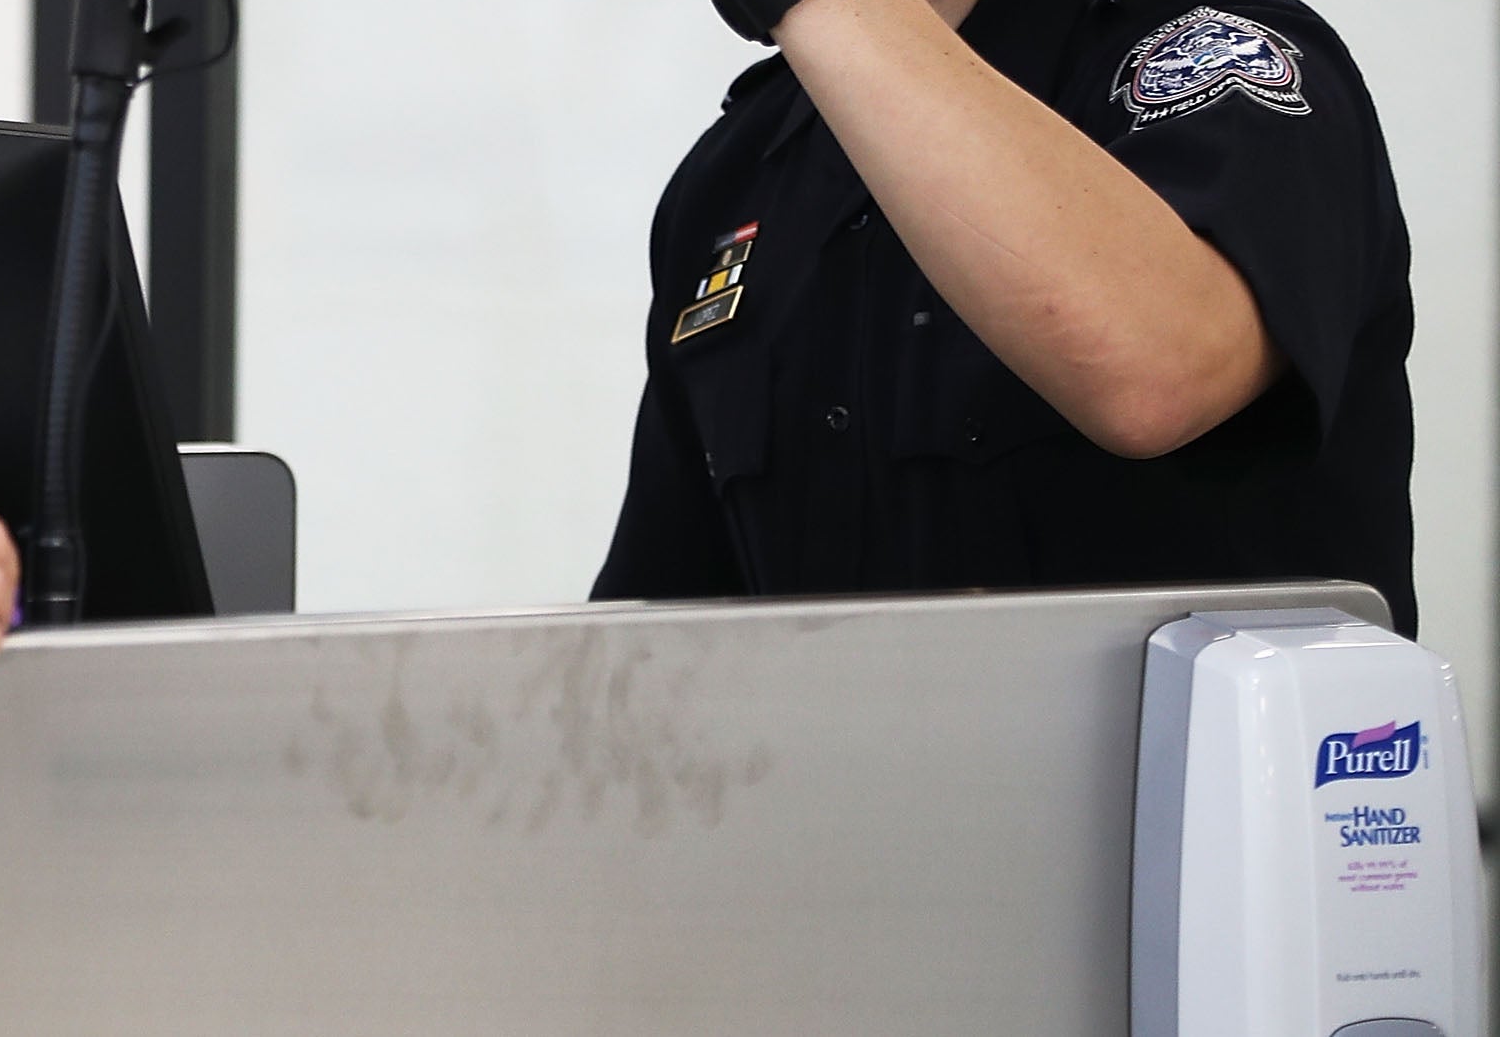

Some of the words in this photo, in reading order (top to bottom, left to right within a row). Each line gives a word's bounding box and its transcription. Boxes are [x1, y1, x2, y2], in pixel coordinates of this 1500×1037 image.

[1170, 96, 1206, 114] FIELD
[1325, 739, 1411, 775] Purell
[1353, 806, 1406, 827] HAND
[1340, 825, 1421, 847] SANITIZER
